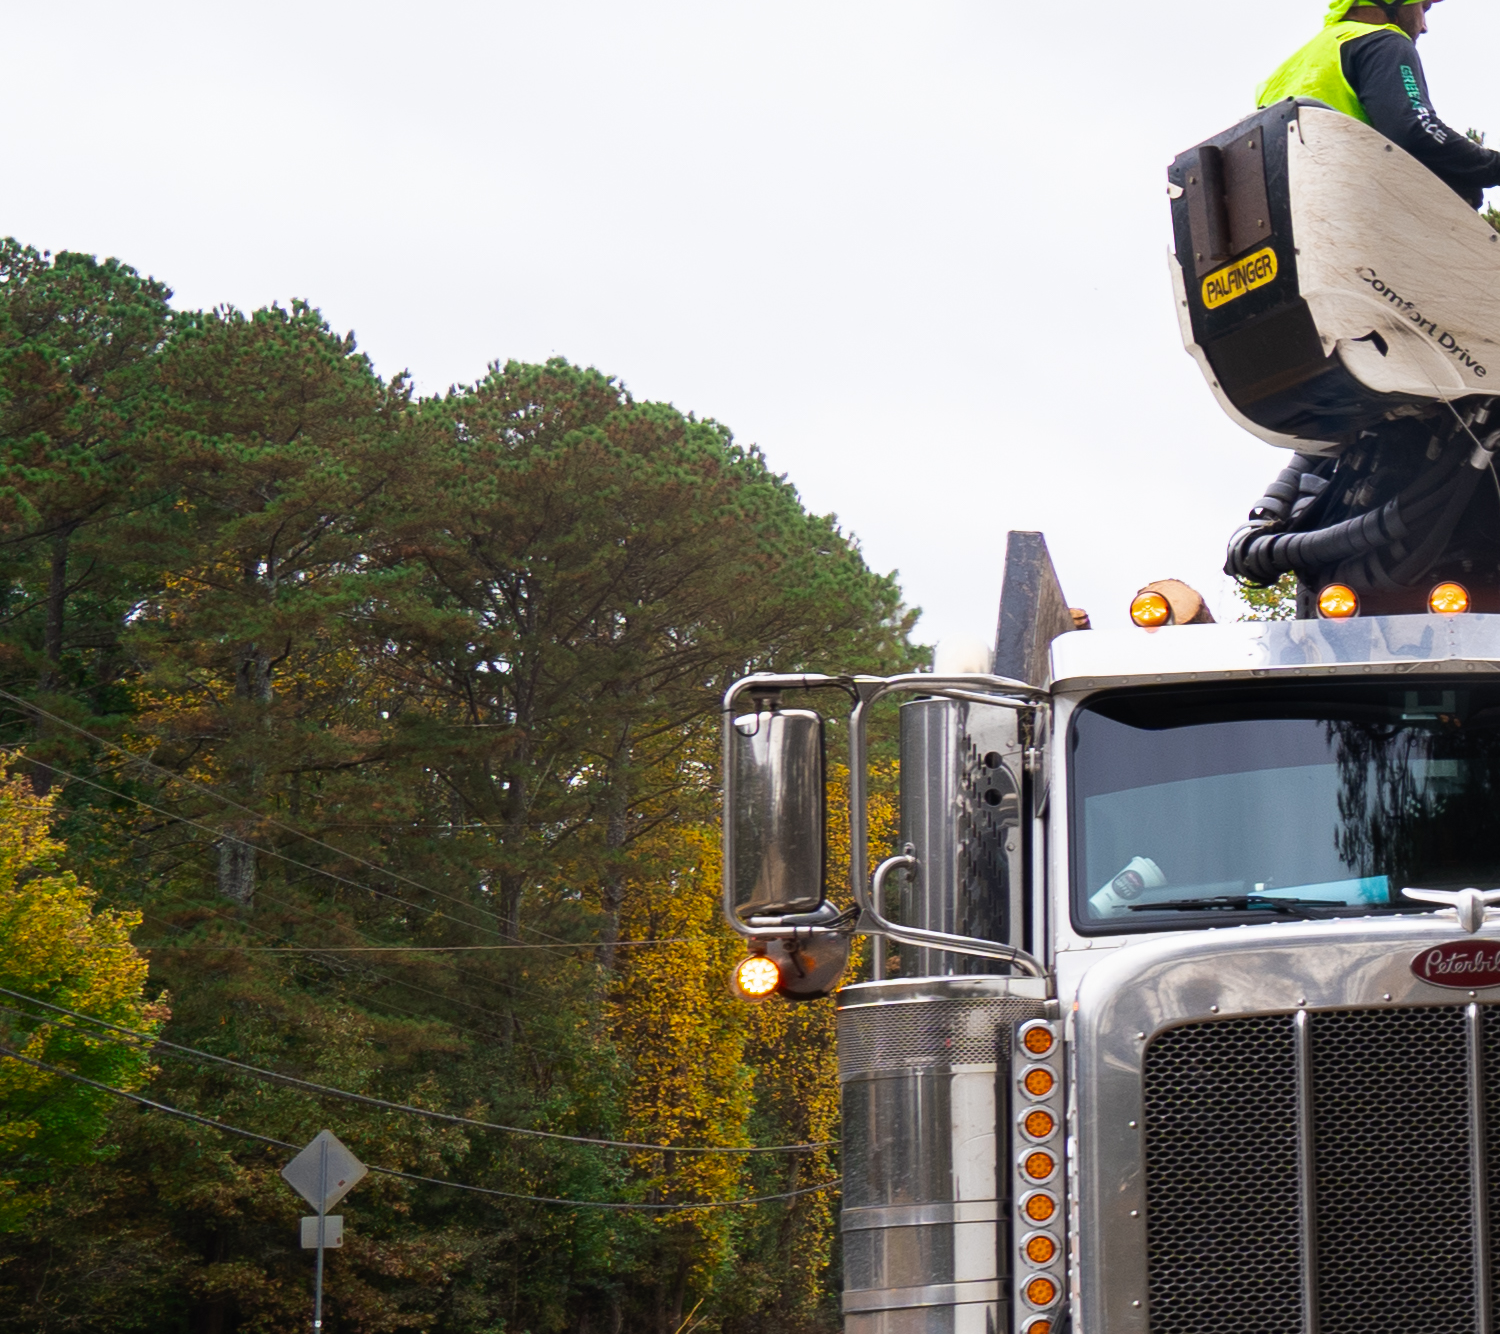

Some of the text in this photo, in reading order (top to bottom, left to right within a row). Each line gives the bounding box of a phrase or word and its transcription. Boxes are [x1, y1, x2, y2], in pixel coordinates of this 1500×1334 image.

[1206, 254, 1273, 303] PALFINGER
[1359, 267, 1487, 378] Comfort Drive
